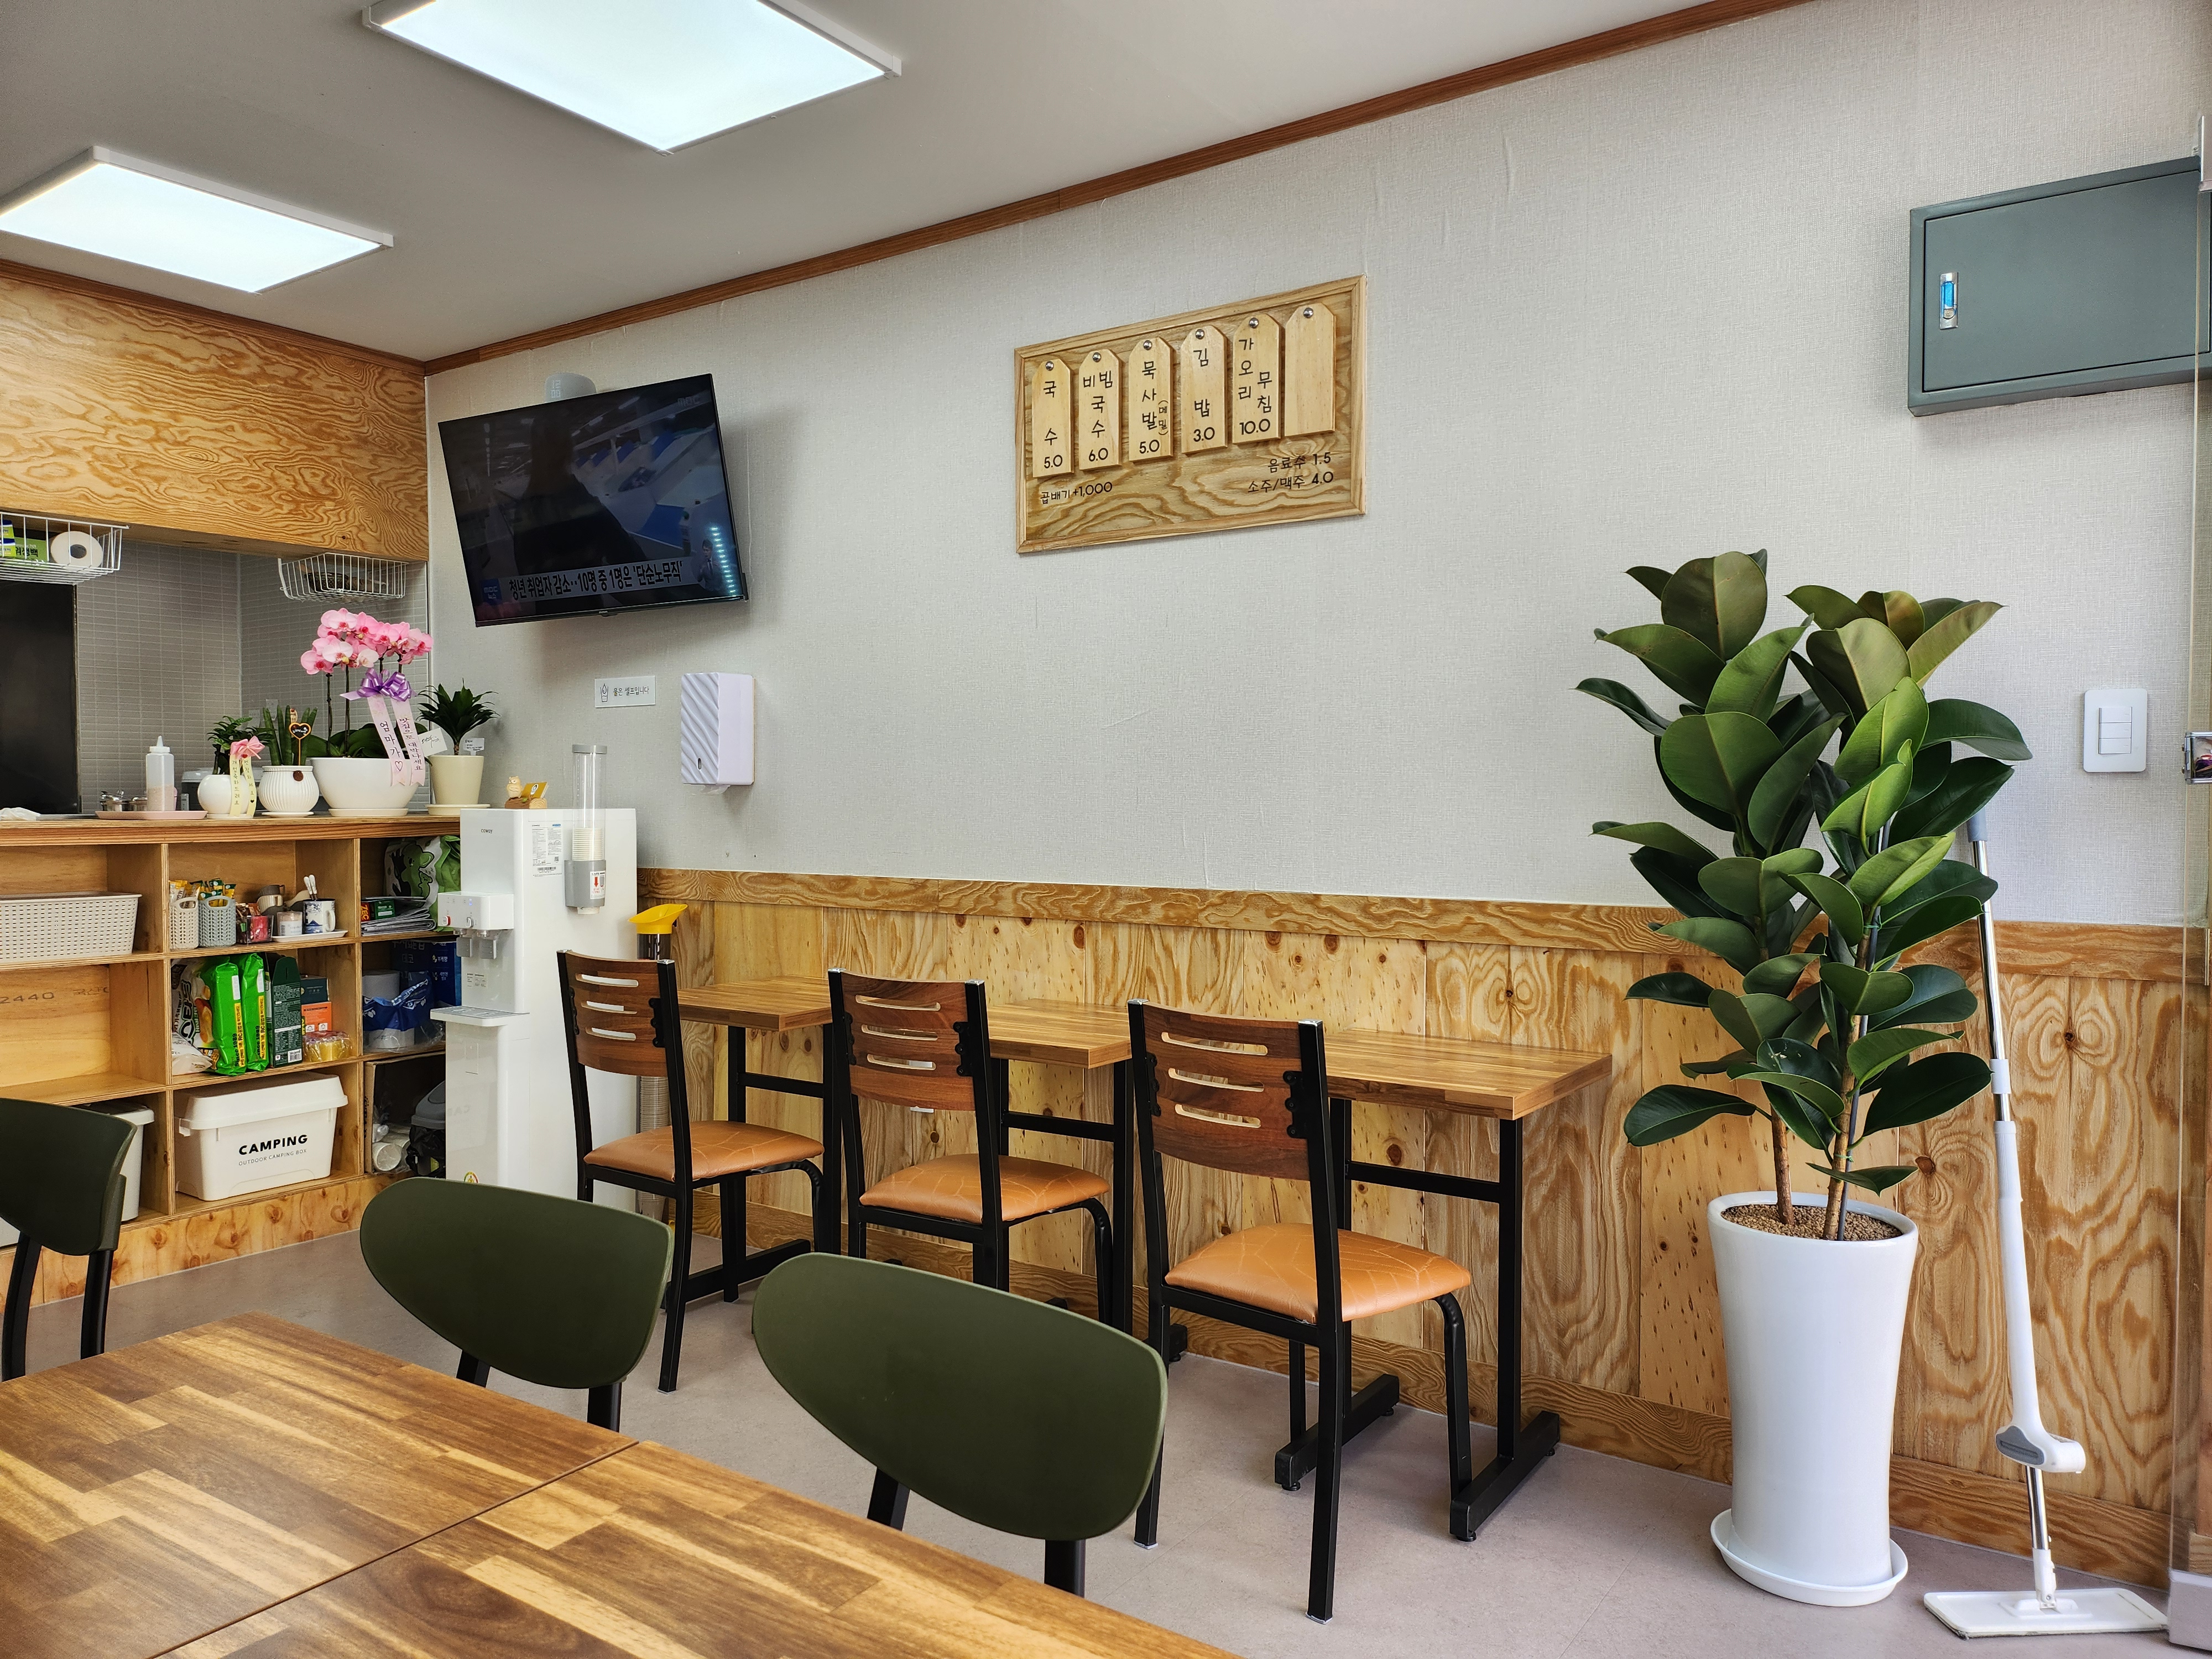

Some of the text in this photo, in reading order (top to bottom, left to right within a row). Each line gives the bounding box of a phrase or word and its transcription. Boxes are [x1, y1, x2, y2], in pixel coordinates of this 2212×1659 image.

[1193, 427, 1215, 442] 3.0
[1239, 419, 1270, 435] 10.0
[1088, 447, 1108, 462] 6.0
[1139, 439, 1160, 453] 5.0
[1044, 455, 1063, 468] 5.0
[1268, 452, 1331, 473] 음료수 1.5
[1248, 471, 1333, 494] 소주/맥주 4.0
[1040, 482, 1113, 504] 곱배기 +1,000
[509, 579, 527, 601] 청년
[527, 576, 553, 598] 취업자
[598, 570, 607, 591] 중
[609, 566, 632, 589] 1명은
[613, 686, 649, 696] 물은 셀프입니다
[380, 721, 401, 758] 엄마가
[399, 717, 423, 770] 맛집으로 대박나세요
[239, 1134, 308, 1155] CAMPING
[239, 1156, 267, 1166] OUTDOOR
[269, 1151, 294, 1160] CAMPING
